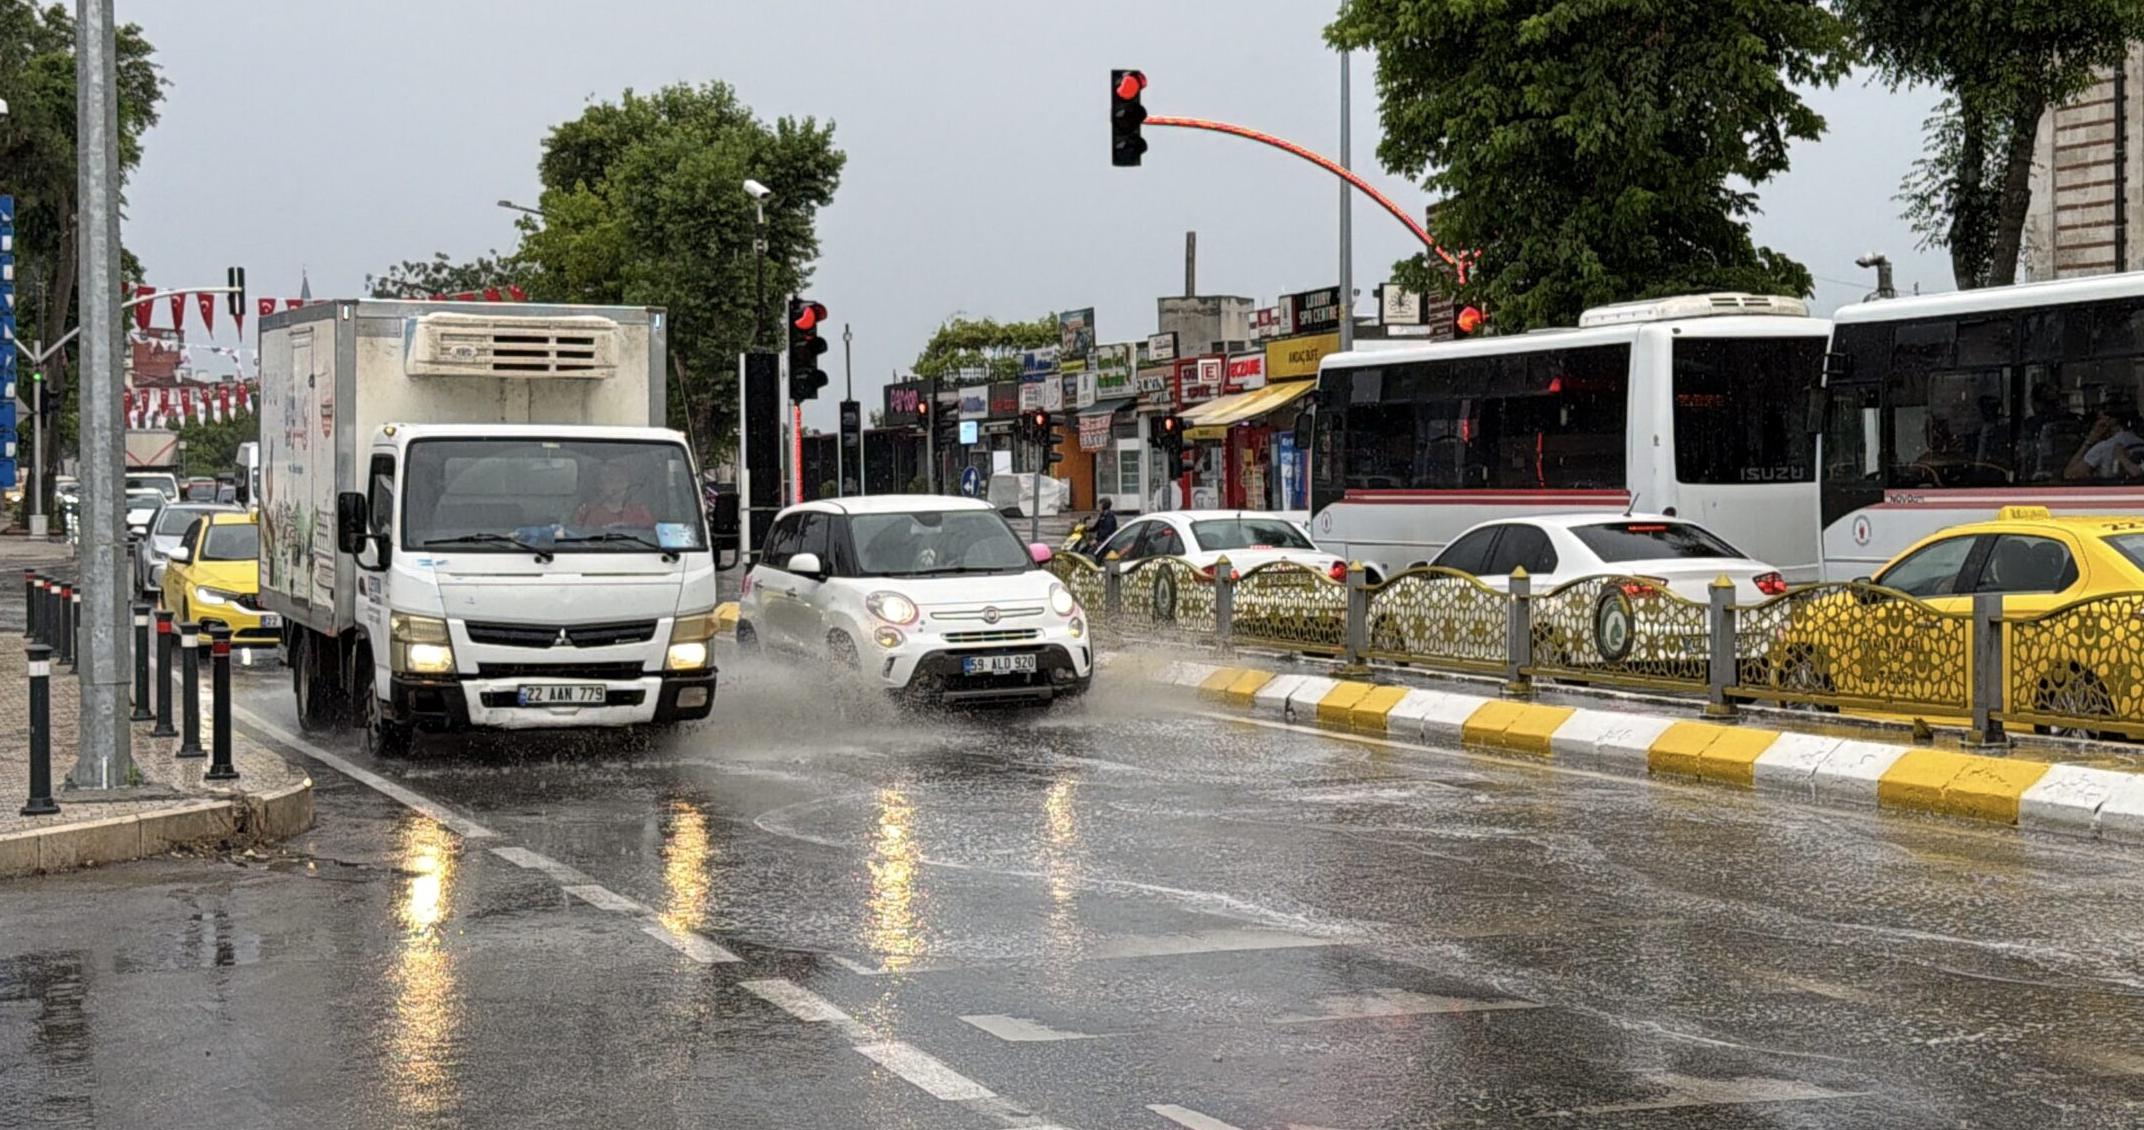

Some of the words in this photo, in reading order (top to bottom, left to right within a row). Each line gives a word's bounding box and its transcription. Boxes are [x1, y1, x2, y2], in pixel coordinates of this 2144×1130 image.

[1299, 310, 1312, 325] SPA
[1313, 304, 1339, 322] CENTRE
[1204, 365, 1215, 378] E
[1740, 466, 1804, 480] ISUZU
[971, 659, 984, 671] 59
[1014, 656, 1035, 669] 920
[528, 688, 542, 701] 22
[549, 687, 572, 701] AAN
[580, 687, 603, 701] 779
